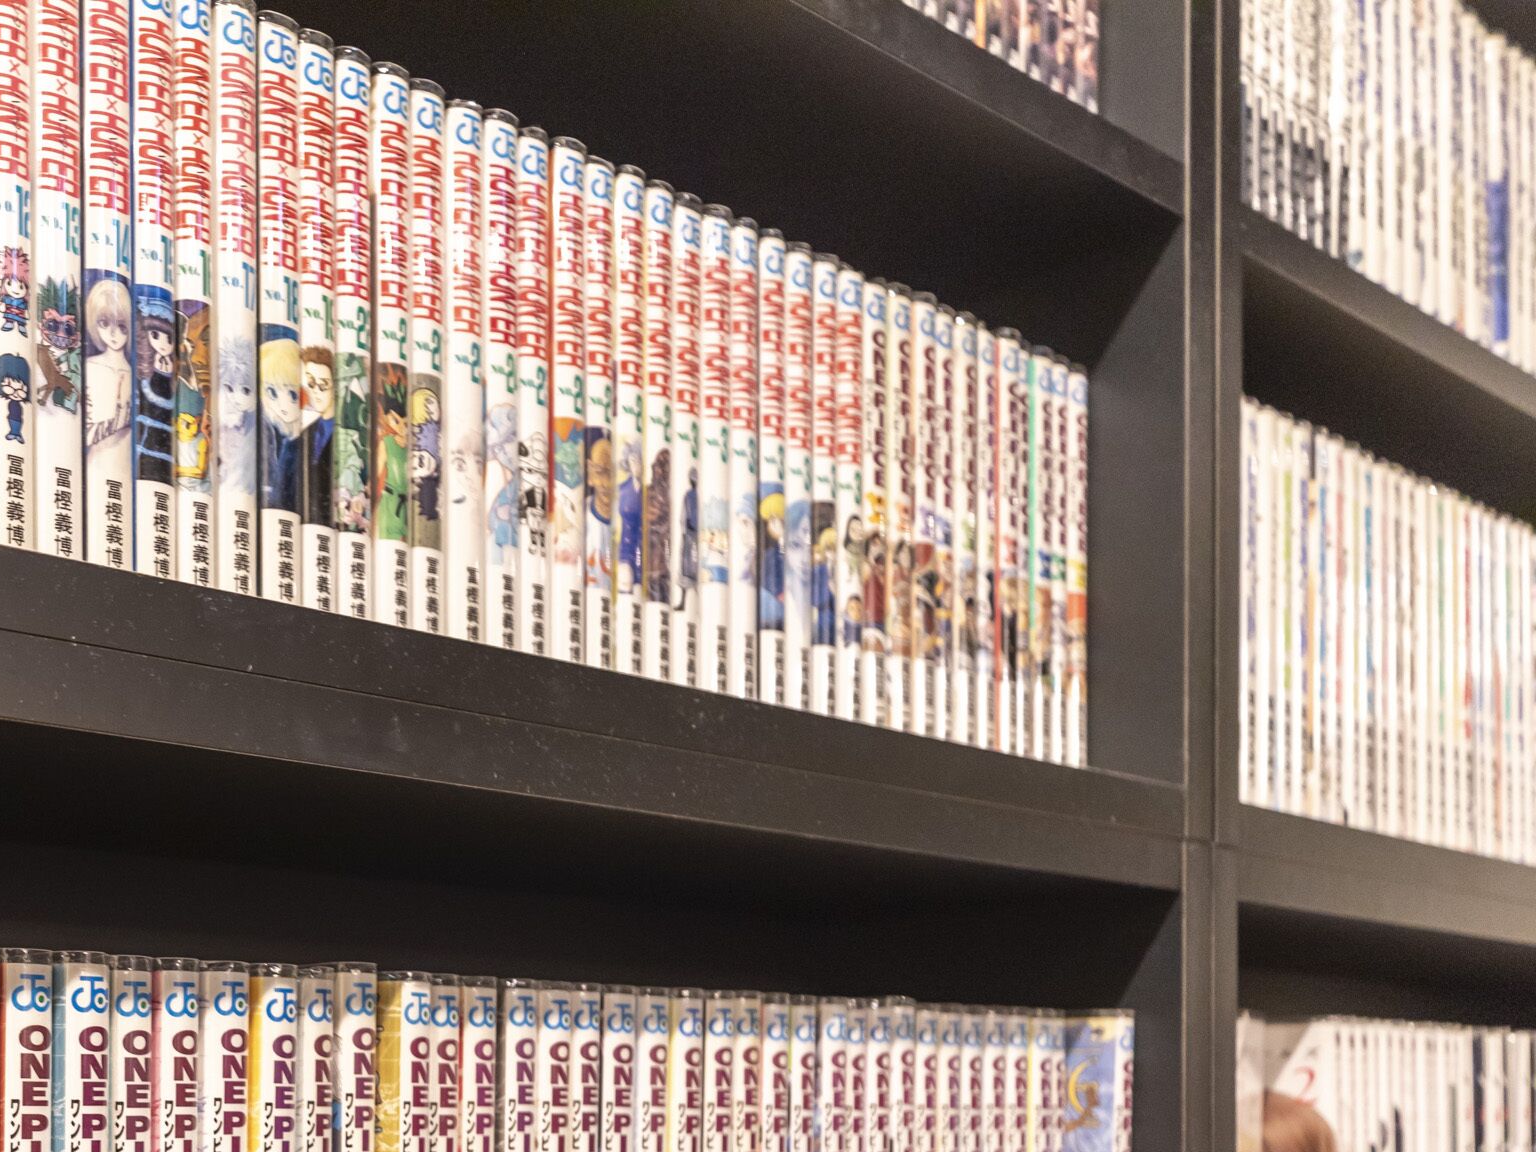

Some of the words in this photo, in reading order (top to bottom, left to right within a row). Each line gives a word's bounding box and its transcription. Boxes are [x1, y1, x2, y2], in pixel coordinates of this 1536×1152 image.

[19, 1025, 50, 1107] ONE
[122, 1030, 151, 1109] ONE
[221, 1029, 248, 1106] ONE
